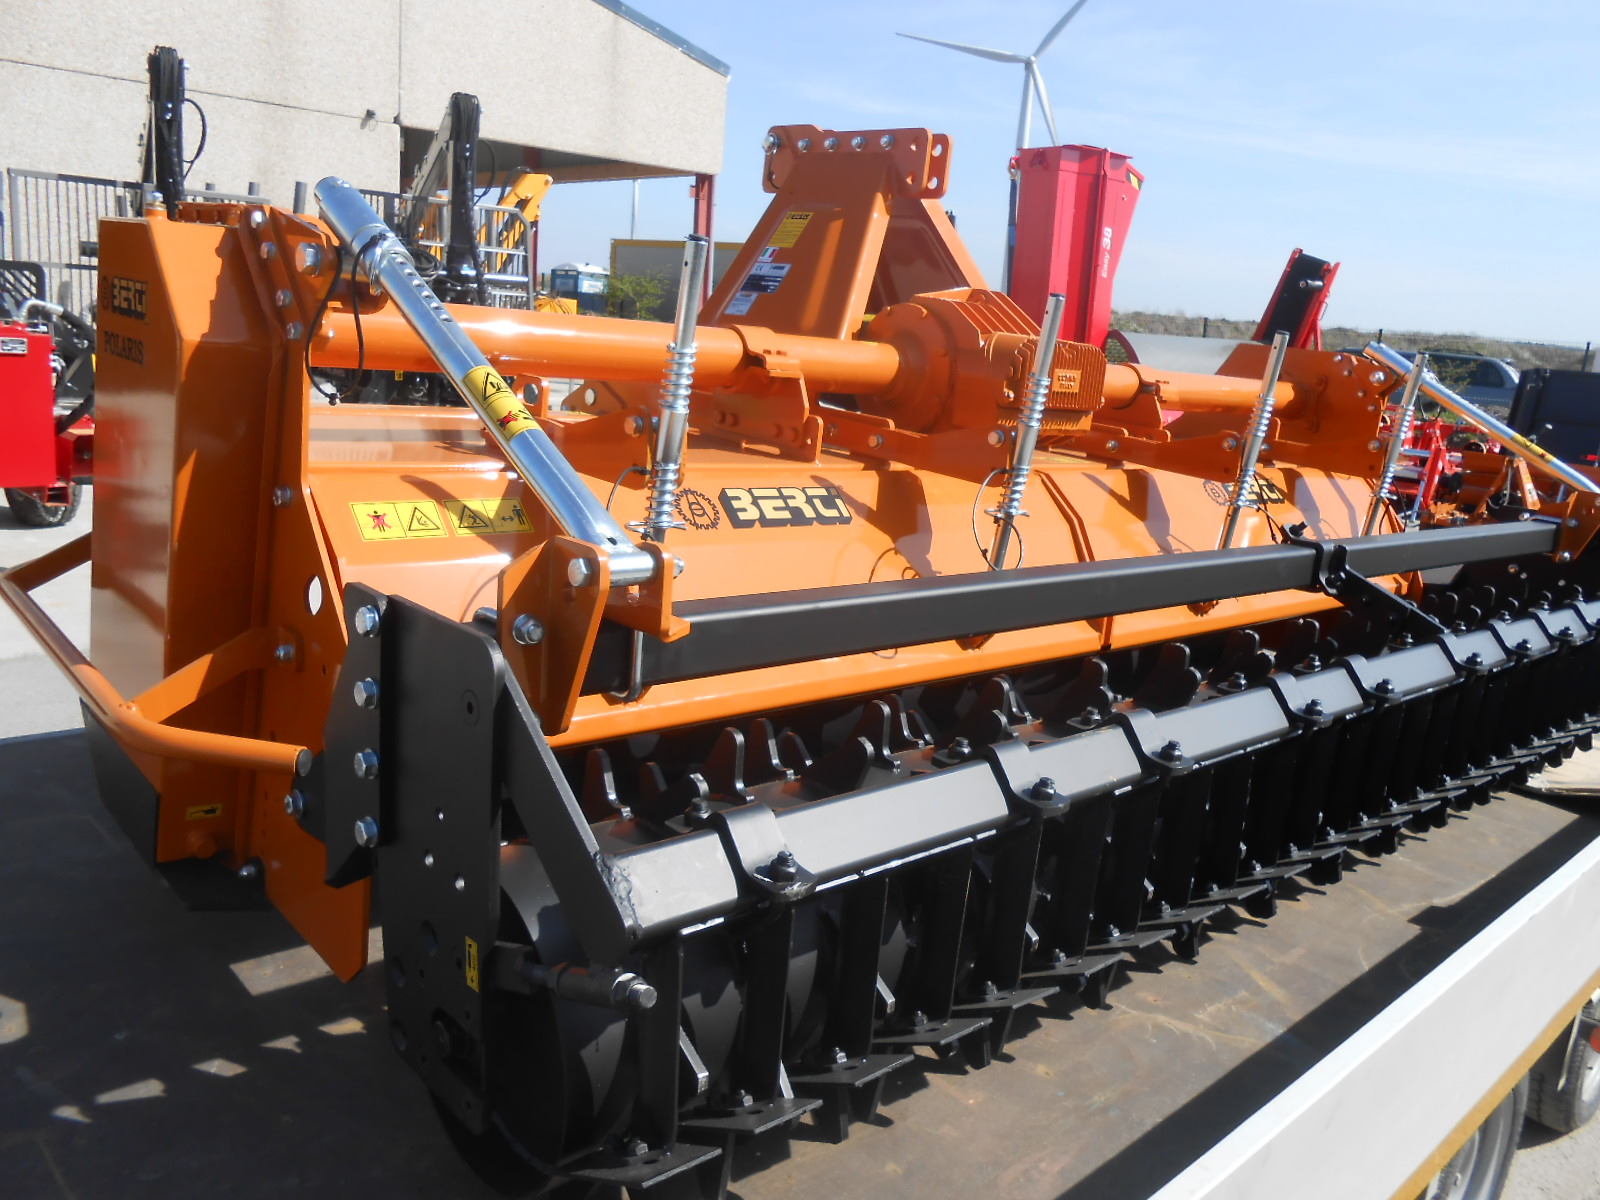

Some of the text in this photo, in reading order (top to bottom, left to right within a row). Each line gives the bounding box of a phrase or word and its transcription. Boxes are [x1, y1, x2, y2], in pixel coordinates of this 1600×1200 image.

[1101, 227, 1113, 278] Easy 38
[111, 275, 148, 320] BERTI
[104, 330, 144, 365] POLARIS
[718, 487, 853, 528] BERTI
